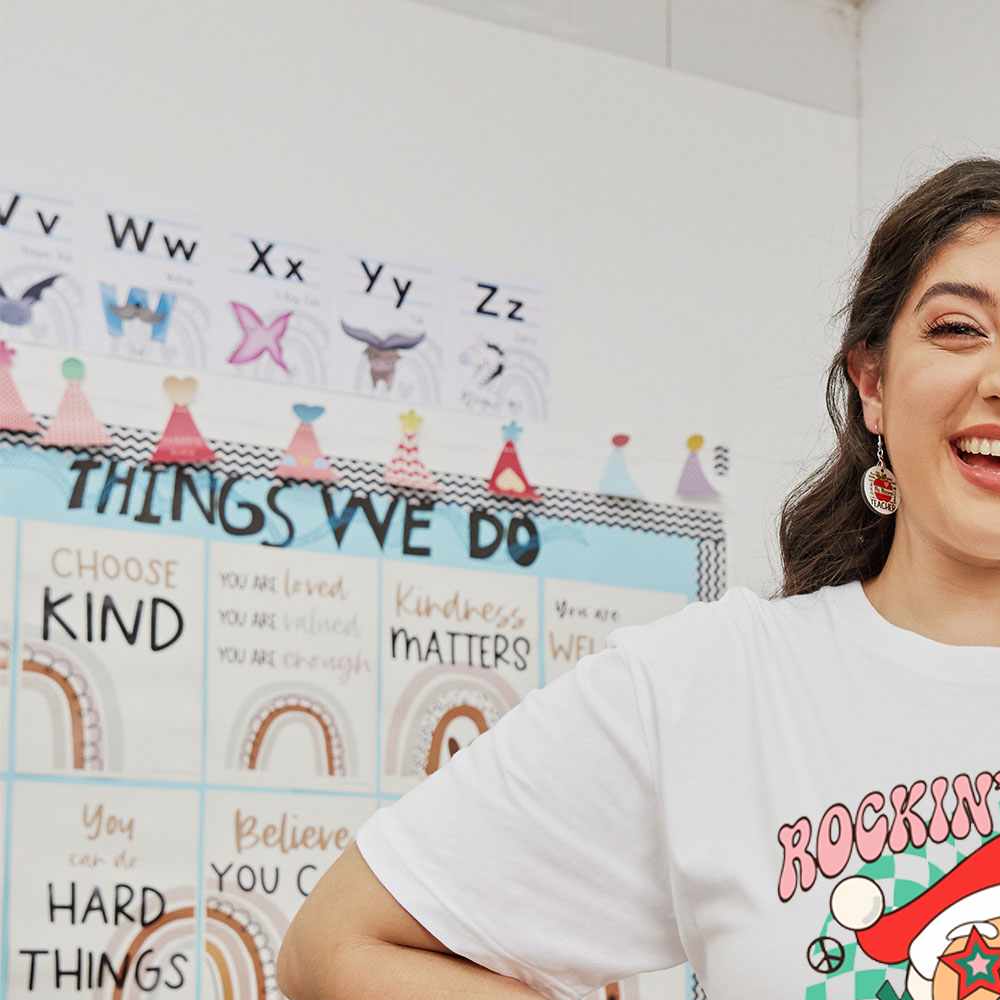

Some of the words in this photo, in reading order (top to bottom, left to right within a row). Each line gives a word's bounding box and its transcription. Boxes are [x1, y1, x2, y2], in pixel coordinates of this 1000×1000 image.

[68, 459, 295, 549] THINGS
[320, 485, 435, 557] WE
[468, 506, 541, 567] DO
[51, 547, 179, 589] CHOOSE
[219, 571, 248, 590] YOU
[252, 573, 277, 593] ARE
[283, 568, 348, 601] loved
[43, 586, 184, 652] KIND
[218, 607, 248, 629] YOU
[251, 611, 277, 632] ARE
[394, 580, 527, 631] Kindness
[217, 645, 247, 665] YOU
[250, 648, 277, 669] ARE
[281, 650, 372, 685] enough
[82, 803, 136, 841] You
[235, 809, 351, 854] Believe
[113, 848, 137, 869] do
[210, 862, 280, 895] YOU
[48, 881, 166, 928] HARD
[19, 947, 188, 993] THINGS
